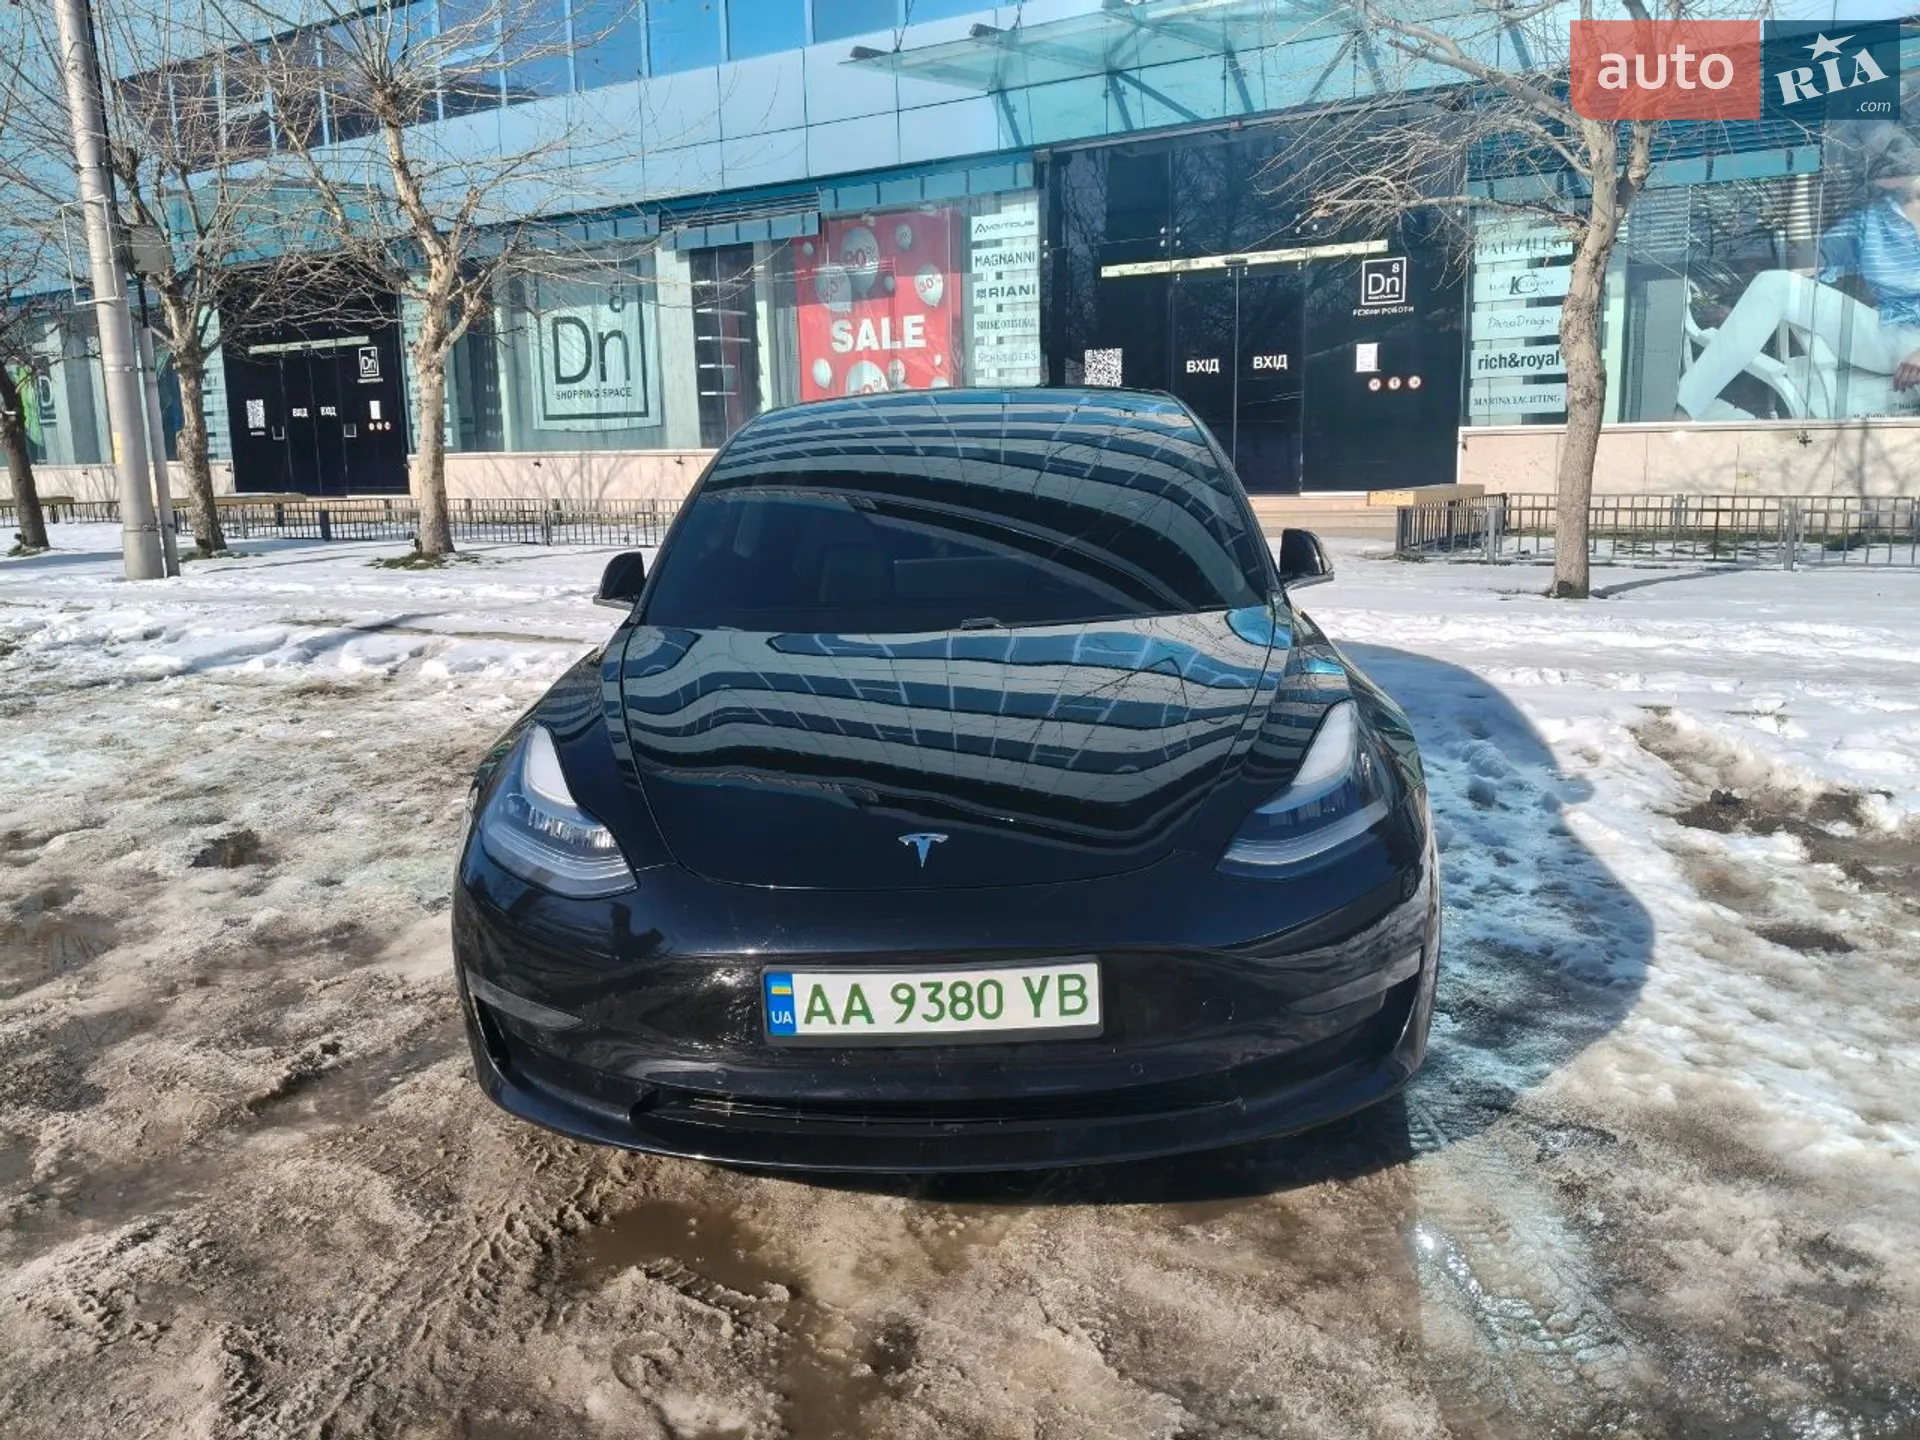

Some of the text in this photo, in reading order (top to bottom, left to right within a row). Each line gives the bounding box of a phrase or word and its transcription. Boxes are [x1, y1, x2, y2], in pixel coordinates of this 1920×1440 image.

[975, 251, 1035, 267] MAGNANNI
[989, 284, 1035, 298] RIANI
[1368, 273, 1400, 295] Dn
[1381, 306, 1415, 315] РОБОТИ
[831, 314, 927, 353] SALE
[551, 316, 631, 384] Dn
[1186, 358, 1220, 374] ВХІД
[1253, 354, 1288, 370] ВХІД
[1478, 350, 1560, 370] rich&royal
[556, 387, 633, 400] SHOPPING SPACE
[804, 973, 1089, 1025] AA 9380 YB
[772, 1011, 793, 1024] UA
